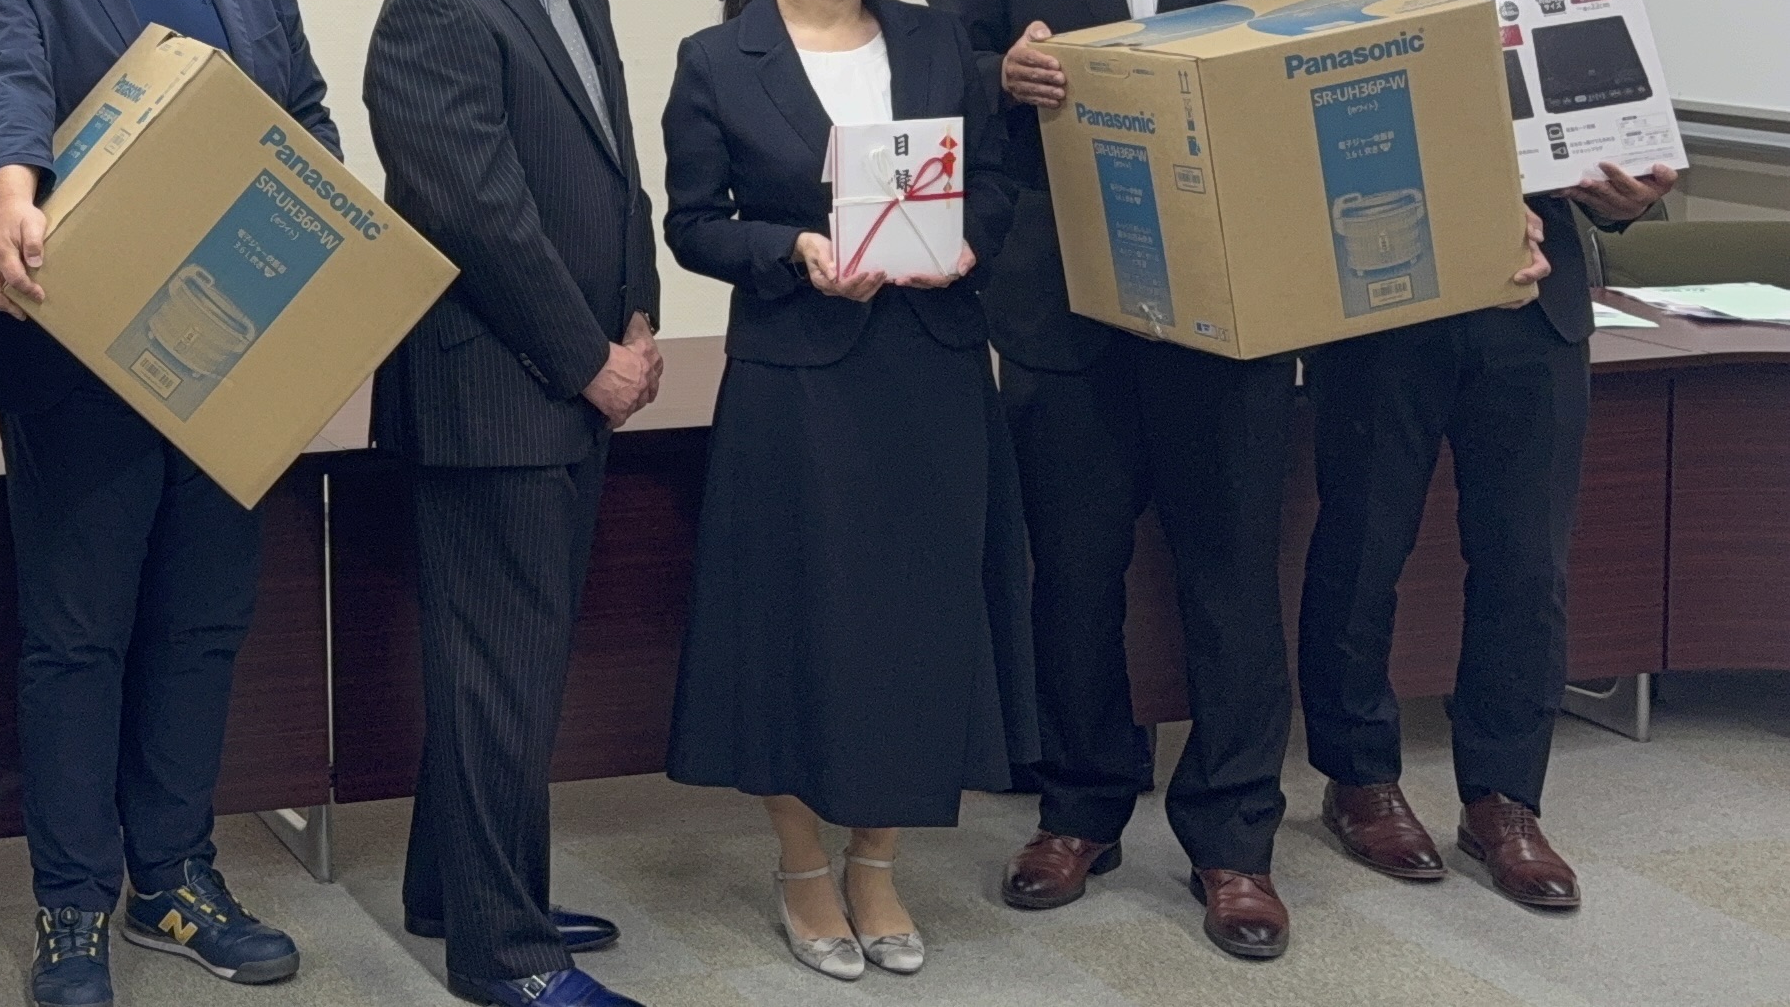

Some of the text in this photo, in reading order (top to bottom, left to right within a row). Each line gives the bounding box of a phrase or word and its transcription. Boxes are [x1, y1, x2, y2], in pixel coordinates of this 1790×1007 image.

[1285, 31, 1425, 79] Panasonic
[1314, 75, 1406, 107] SR-UH36P-W
[1075, 102, 1156, 134] Panasonic
[259, 124, 381, 241] Panasonic
[893, 133, 912, 193] 目録
[256, 175, 340, 250] SR-UH36P-W
[158, 908, 199, 946] N
